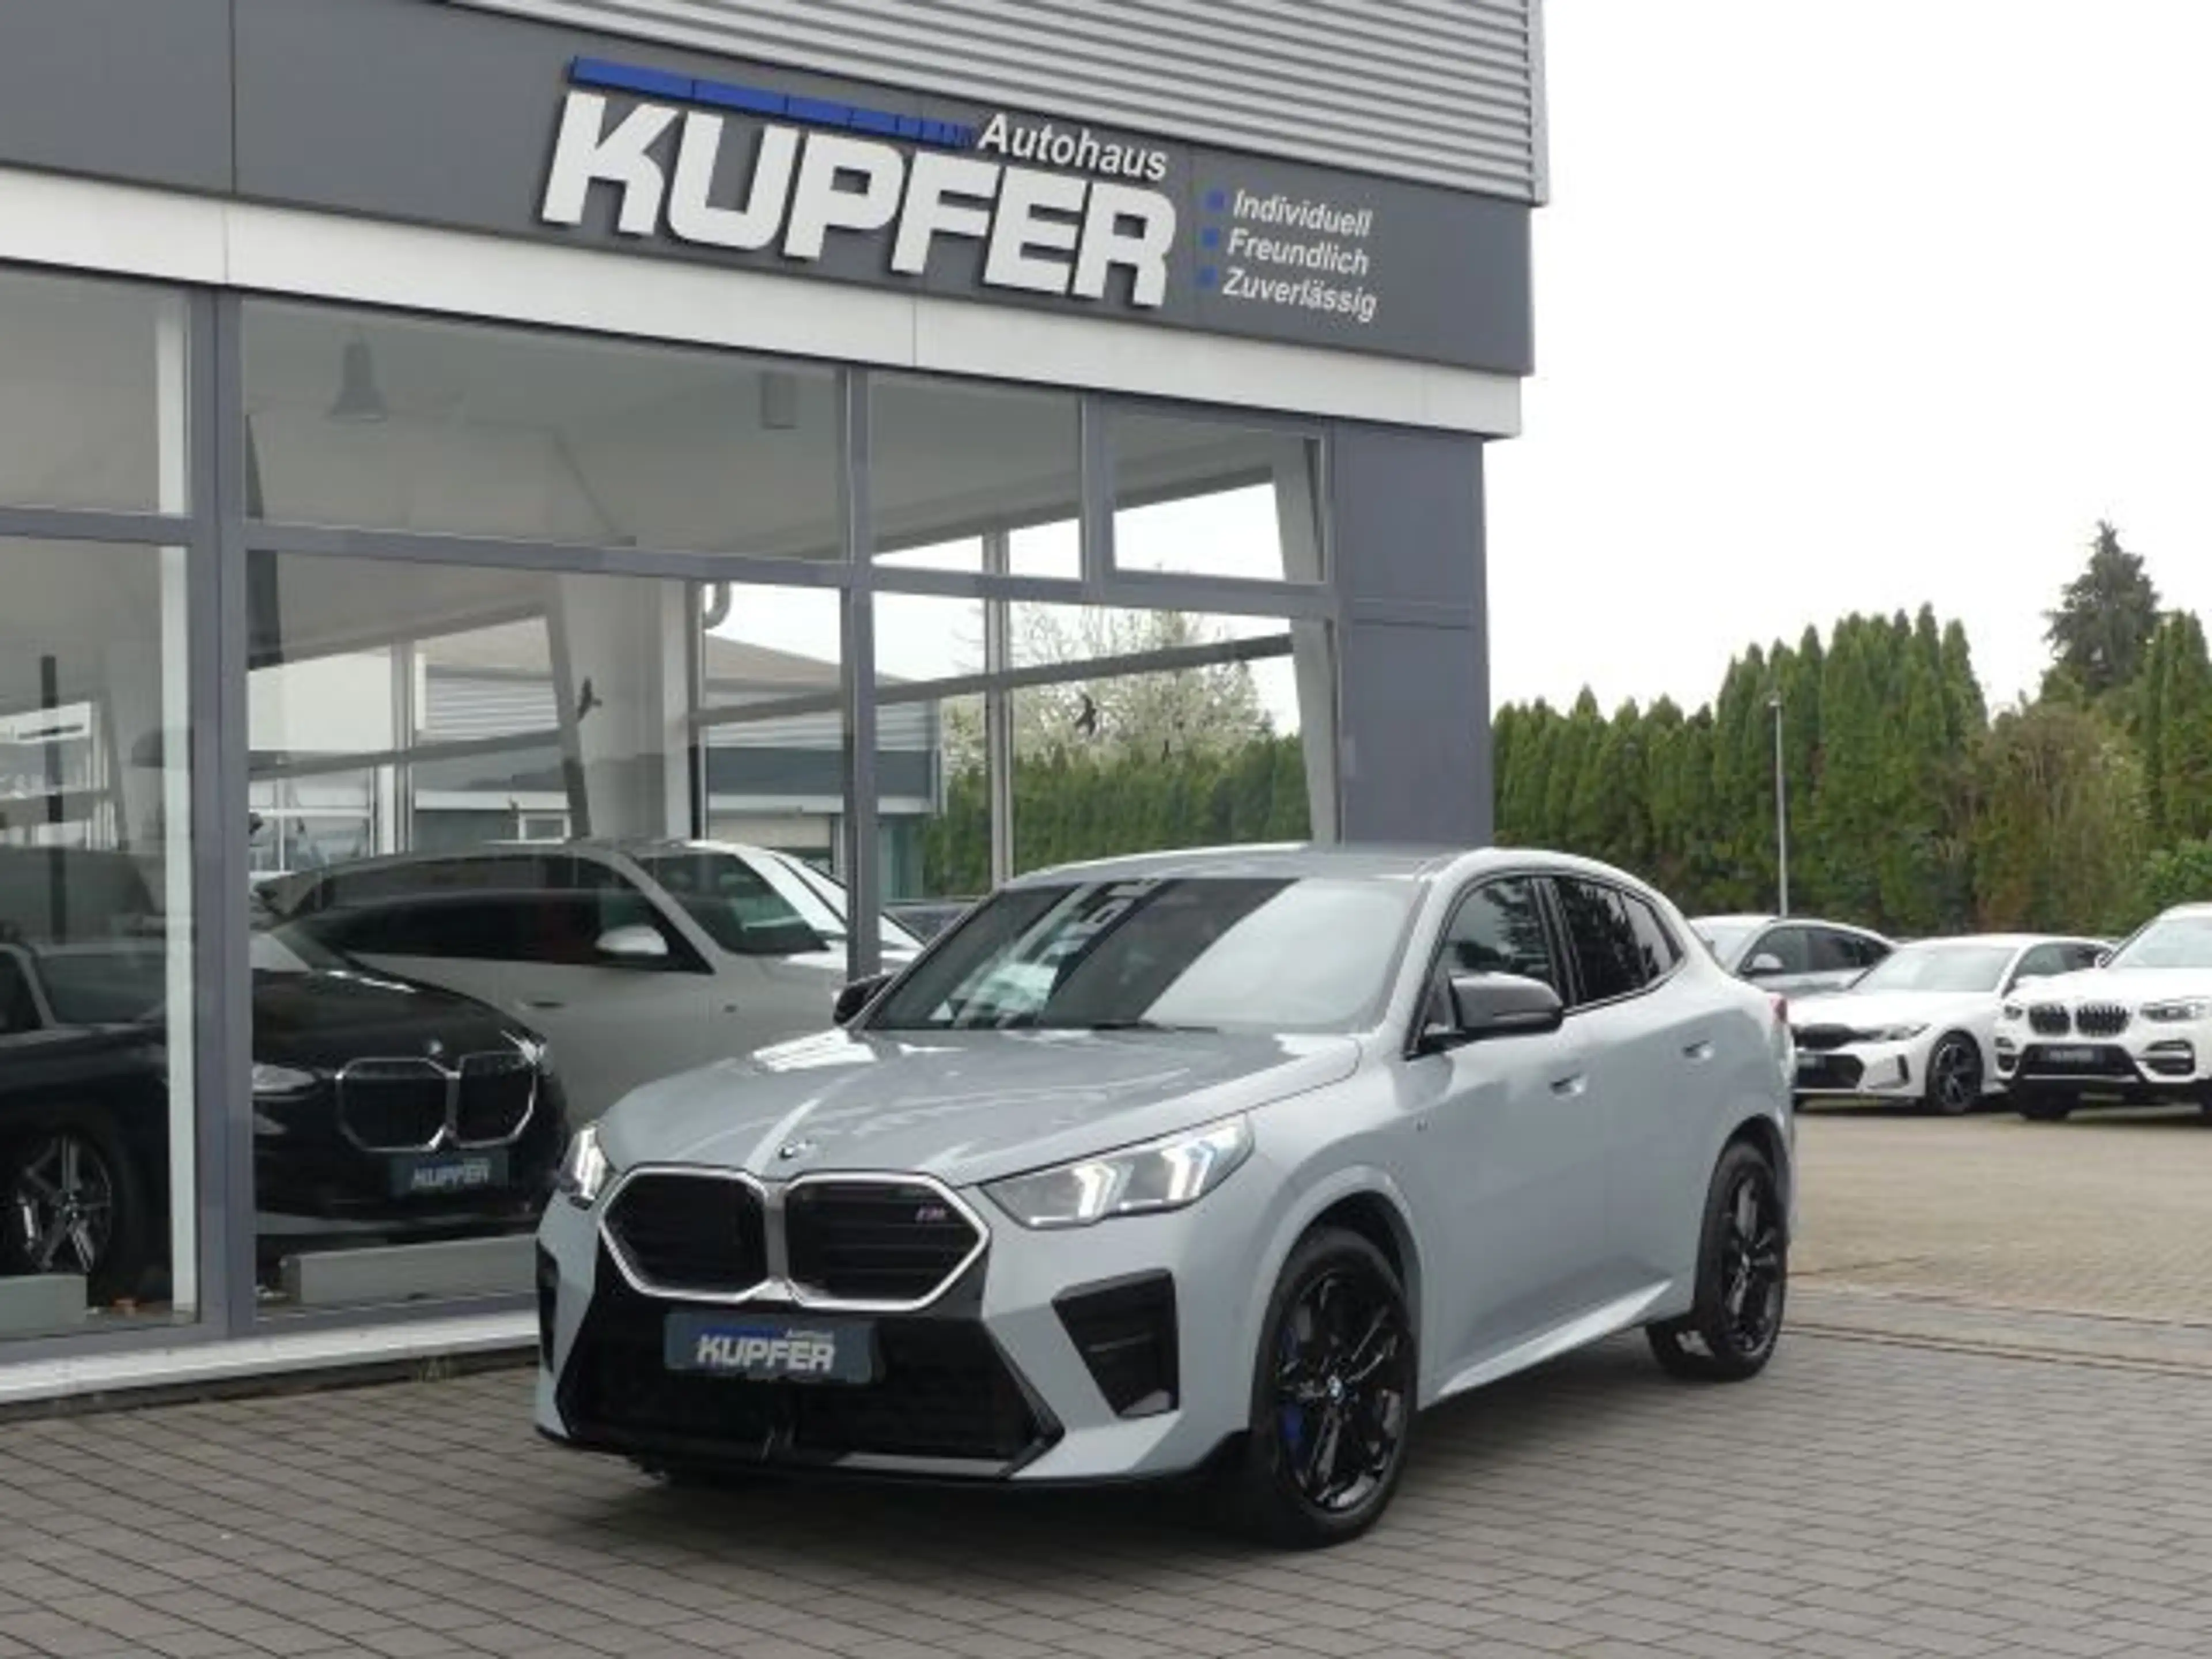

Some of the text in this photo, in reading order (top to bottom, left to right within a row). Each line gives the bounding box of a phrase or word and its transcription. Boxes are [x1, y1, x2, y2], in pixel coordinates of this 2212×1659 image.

[978, 113, 1168, 181] Autohaus
[541, 90, 1177, 308] KUPFER
[1233, 189, 1372, 238] Individuell
[1227, 228, 1370, 276] Freundlich
[1222, 267, 1377, 323] Zuverlässig
[696, 1334, 836, 1373] KUPFER
